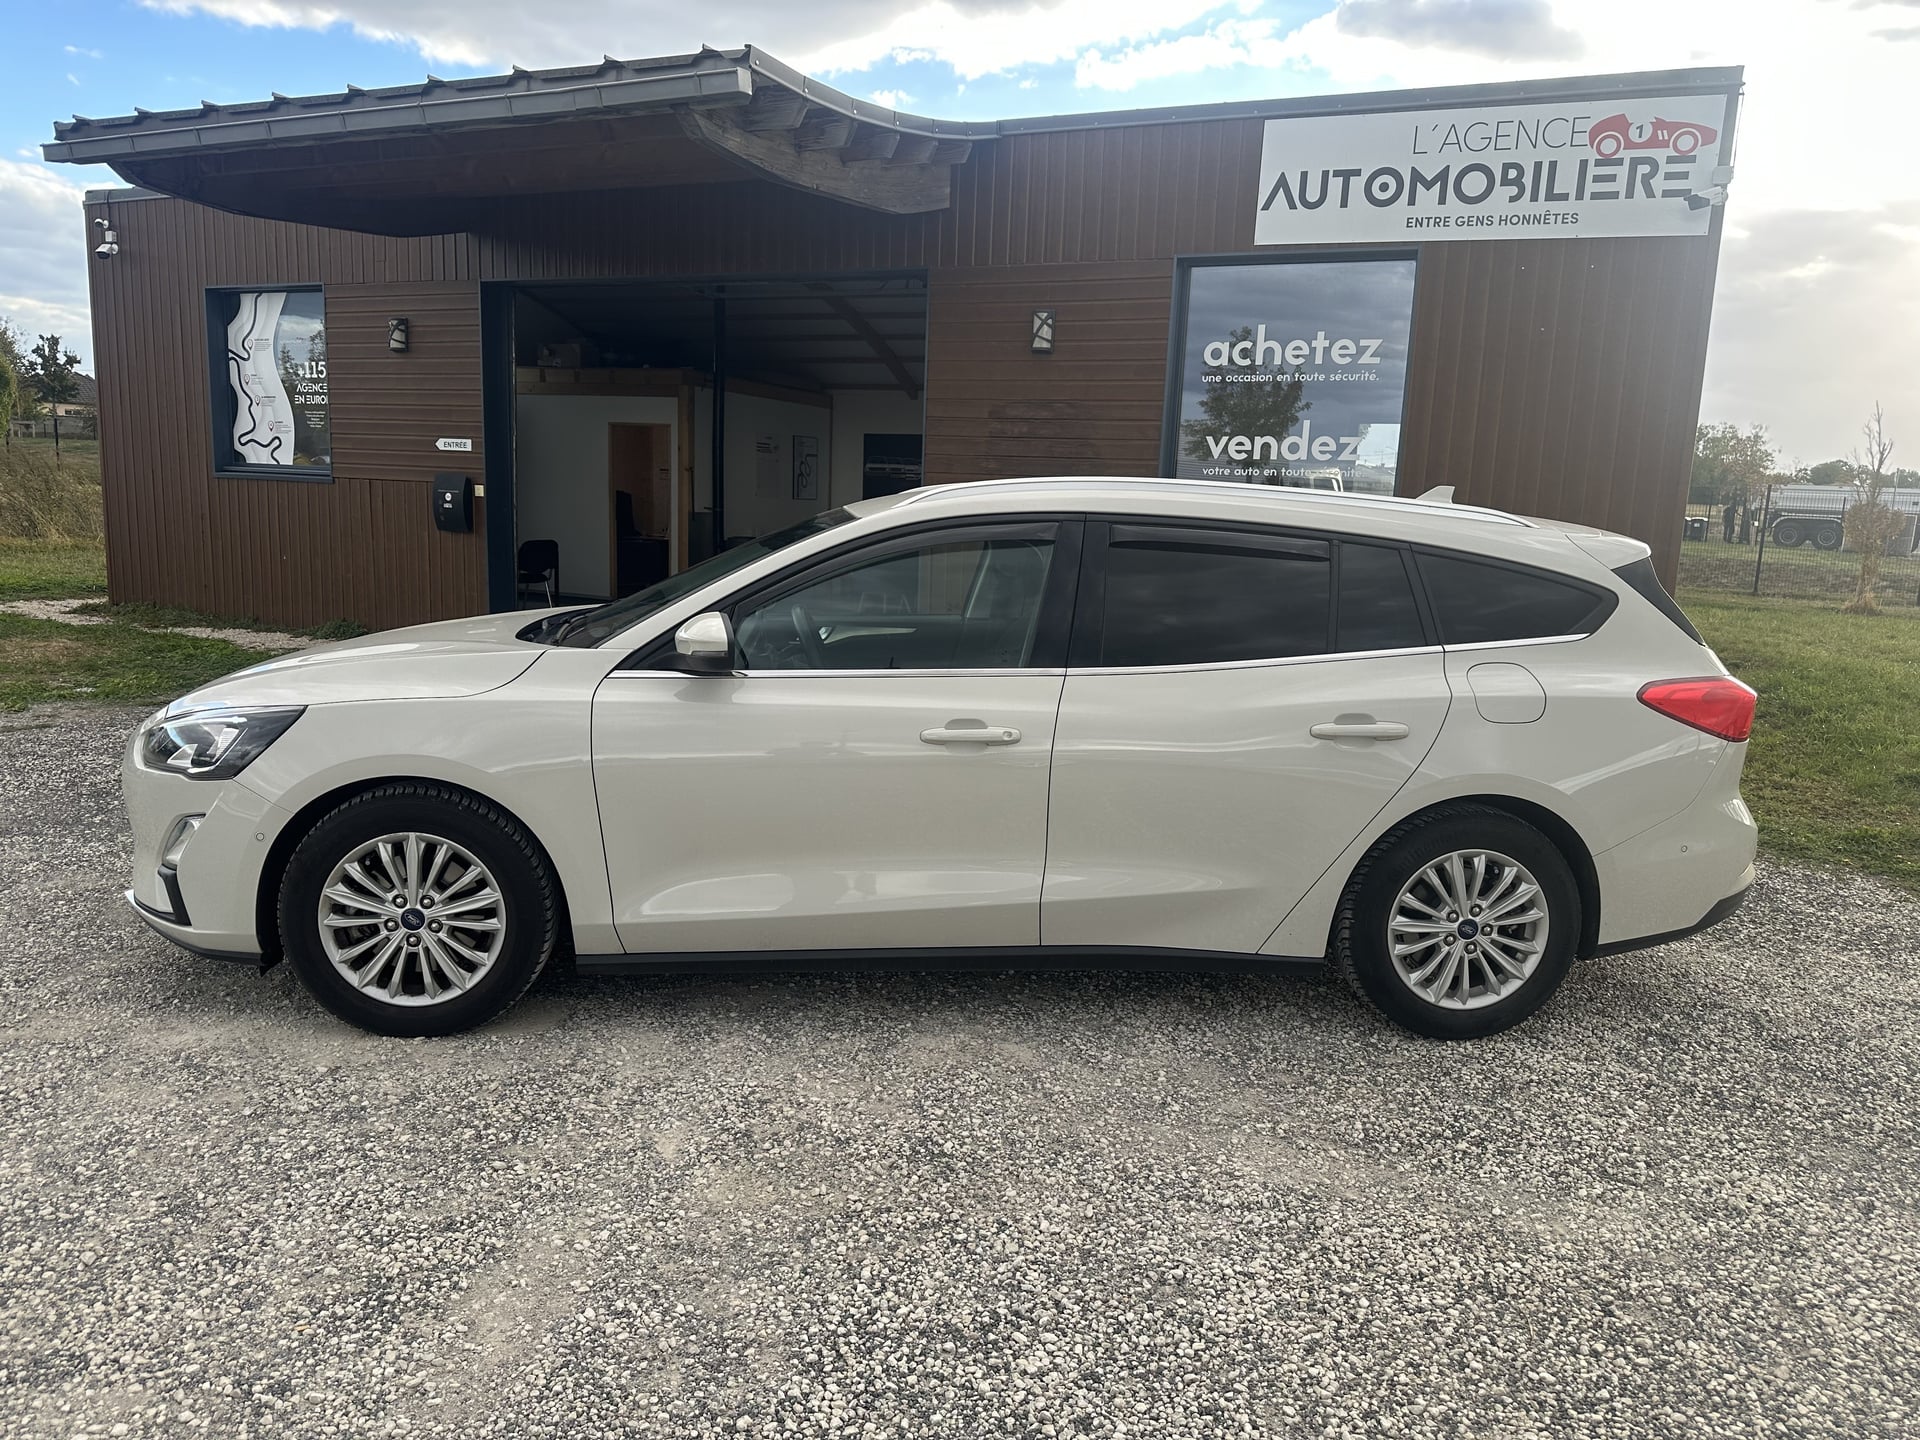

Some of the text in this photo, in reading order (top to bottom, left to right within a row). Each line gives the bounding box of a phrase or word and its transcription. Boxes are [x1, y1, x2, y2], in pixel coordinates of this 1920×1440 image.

[1412, 116, 1591, 155] L'AGENCE
[1635, 124, 1644, 139] 1
[1405, 210, 1579, 229] ENTRE GENS HONNÊTES
[1203, 324, 1384, 367] achetez
[297, 361, 327, 379] +115
[1201, 369, 1380, 383] une occasion en toute sécurité.
[296, 383, 328, 393] AGENCE
[294, 395, 329, 405] EN EURO
[443, 441, 468, 449] ENTRÉE
[1205, 420, 1363, 461] vendez
[1202, 467, 1231, 476] votre
[1234, 467, 1260, 477] auto
[1263, 468, 1277, 476] en
[1281, 467, 1312, 477] toute
